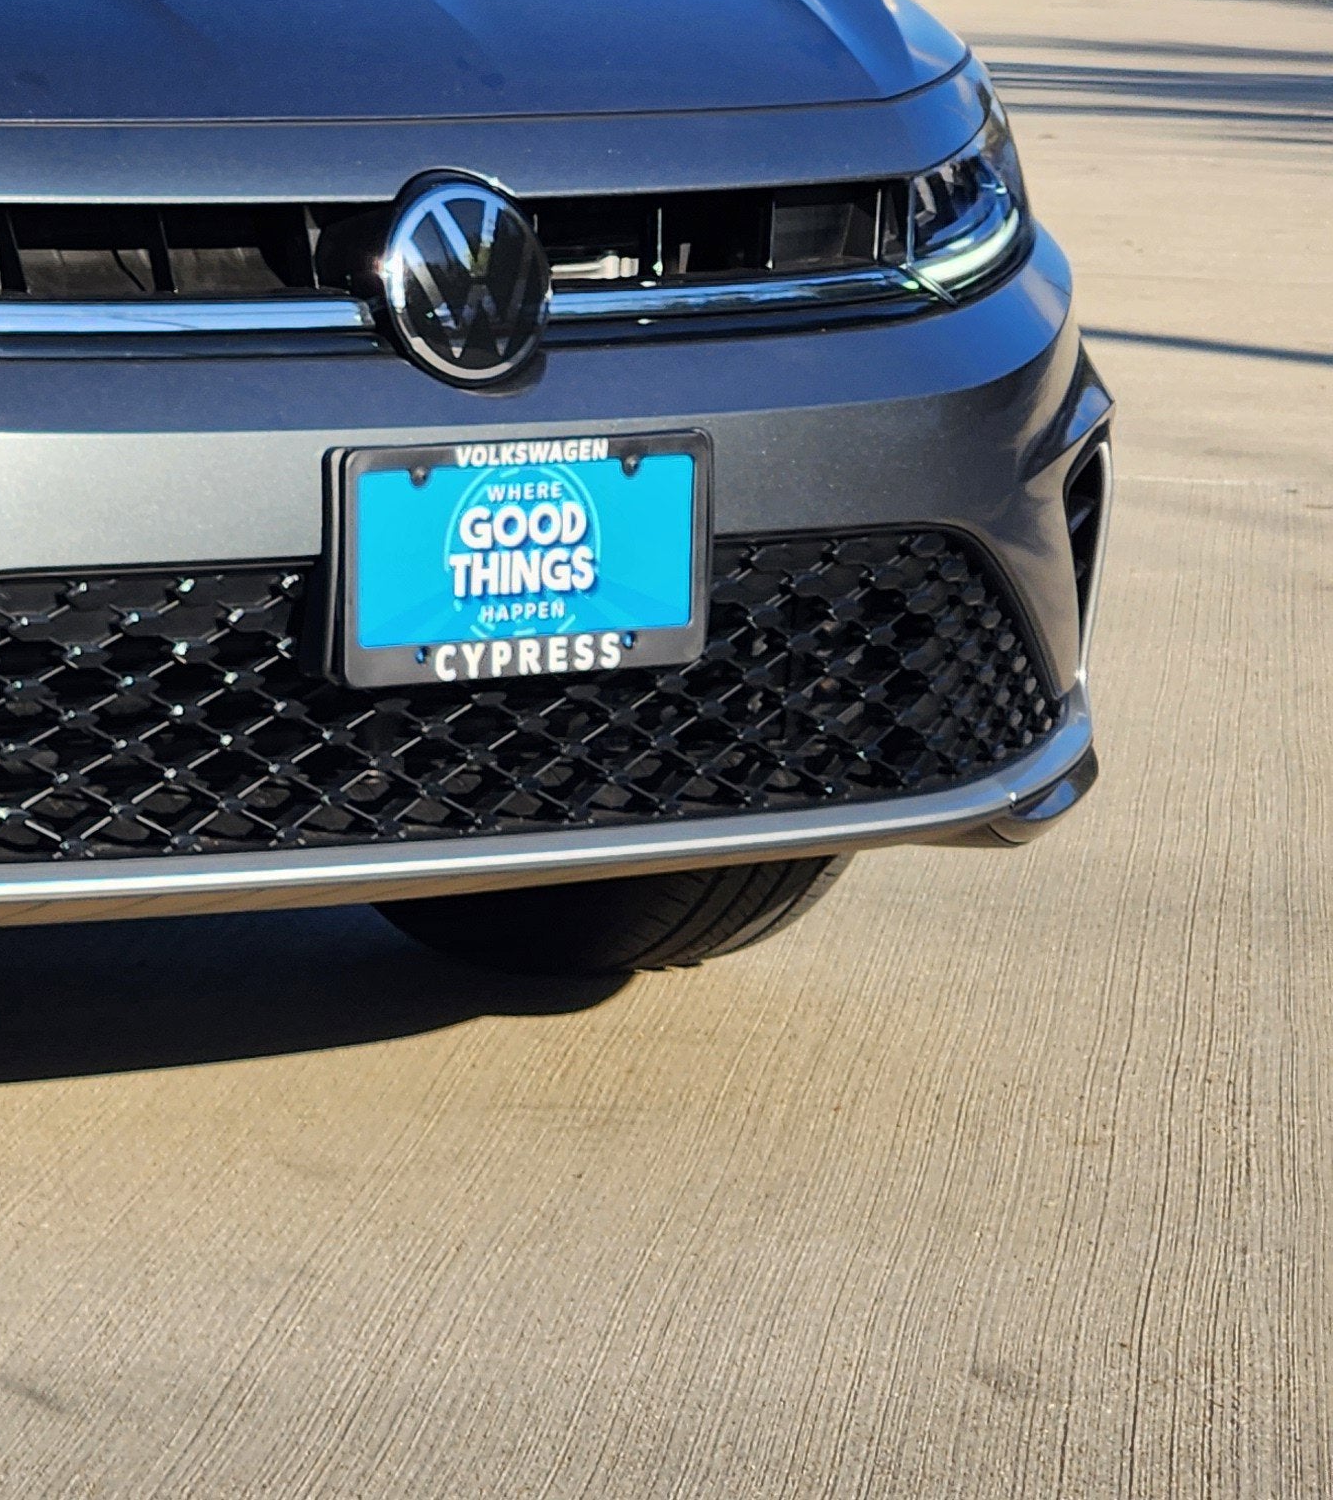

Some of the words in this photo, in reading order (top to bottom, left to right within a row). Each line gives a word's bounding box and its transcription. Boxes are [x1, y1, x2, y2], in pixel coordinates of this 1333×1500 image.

[456, 439, 609, 467] VOLKSWAGEN
[487, 481, 563, 501] WHERE
[459, 502, 587, 549] GOOD
[449, 547, 595, 597] THINGS
[481, 601, 564, 622] HAPPEN
[435, 632, 621, 682] CYPRESS
